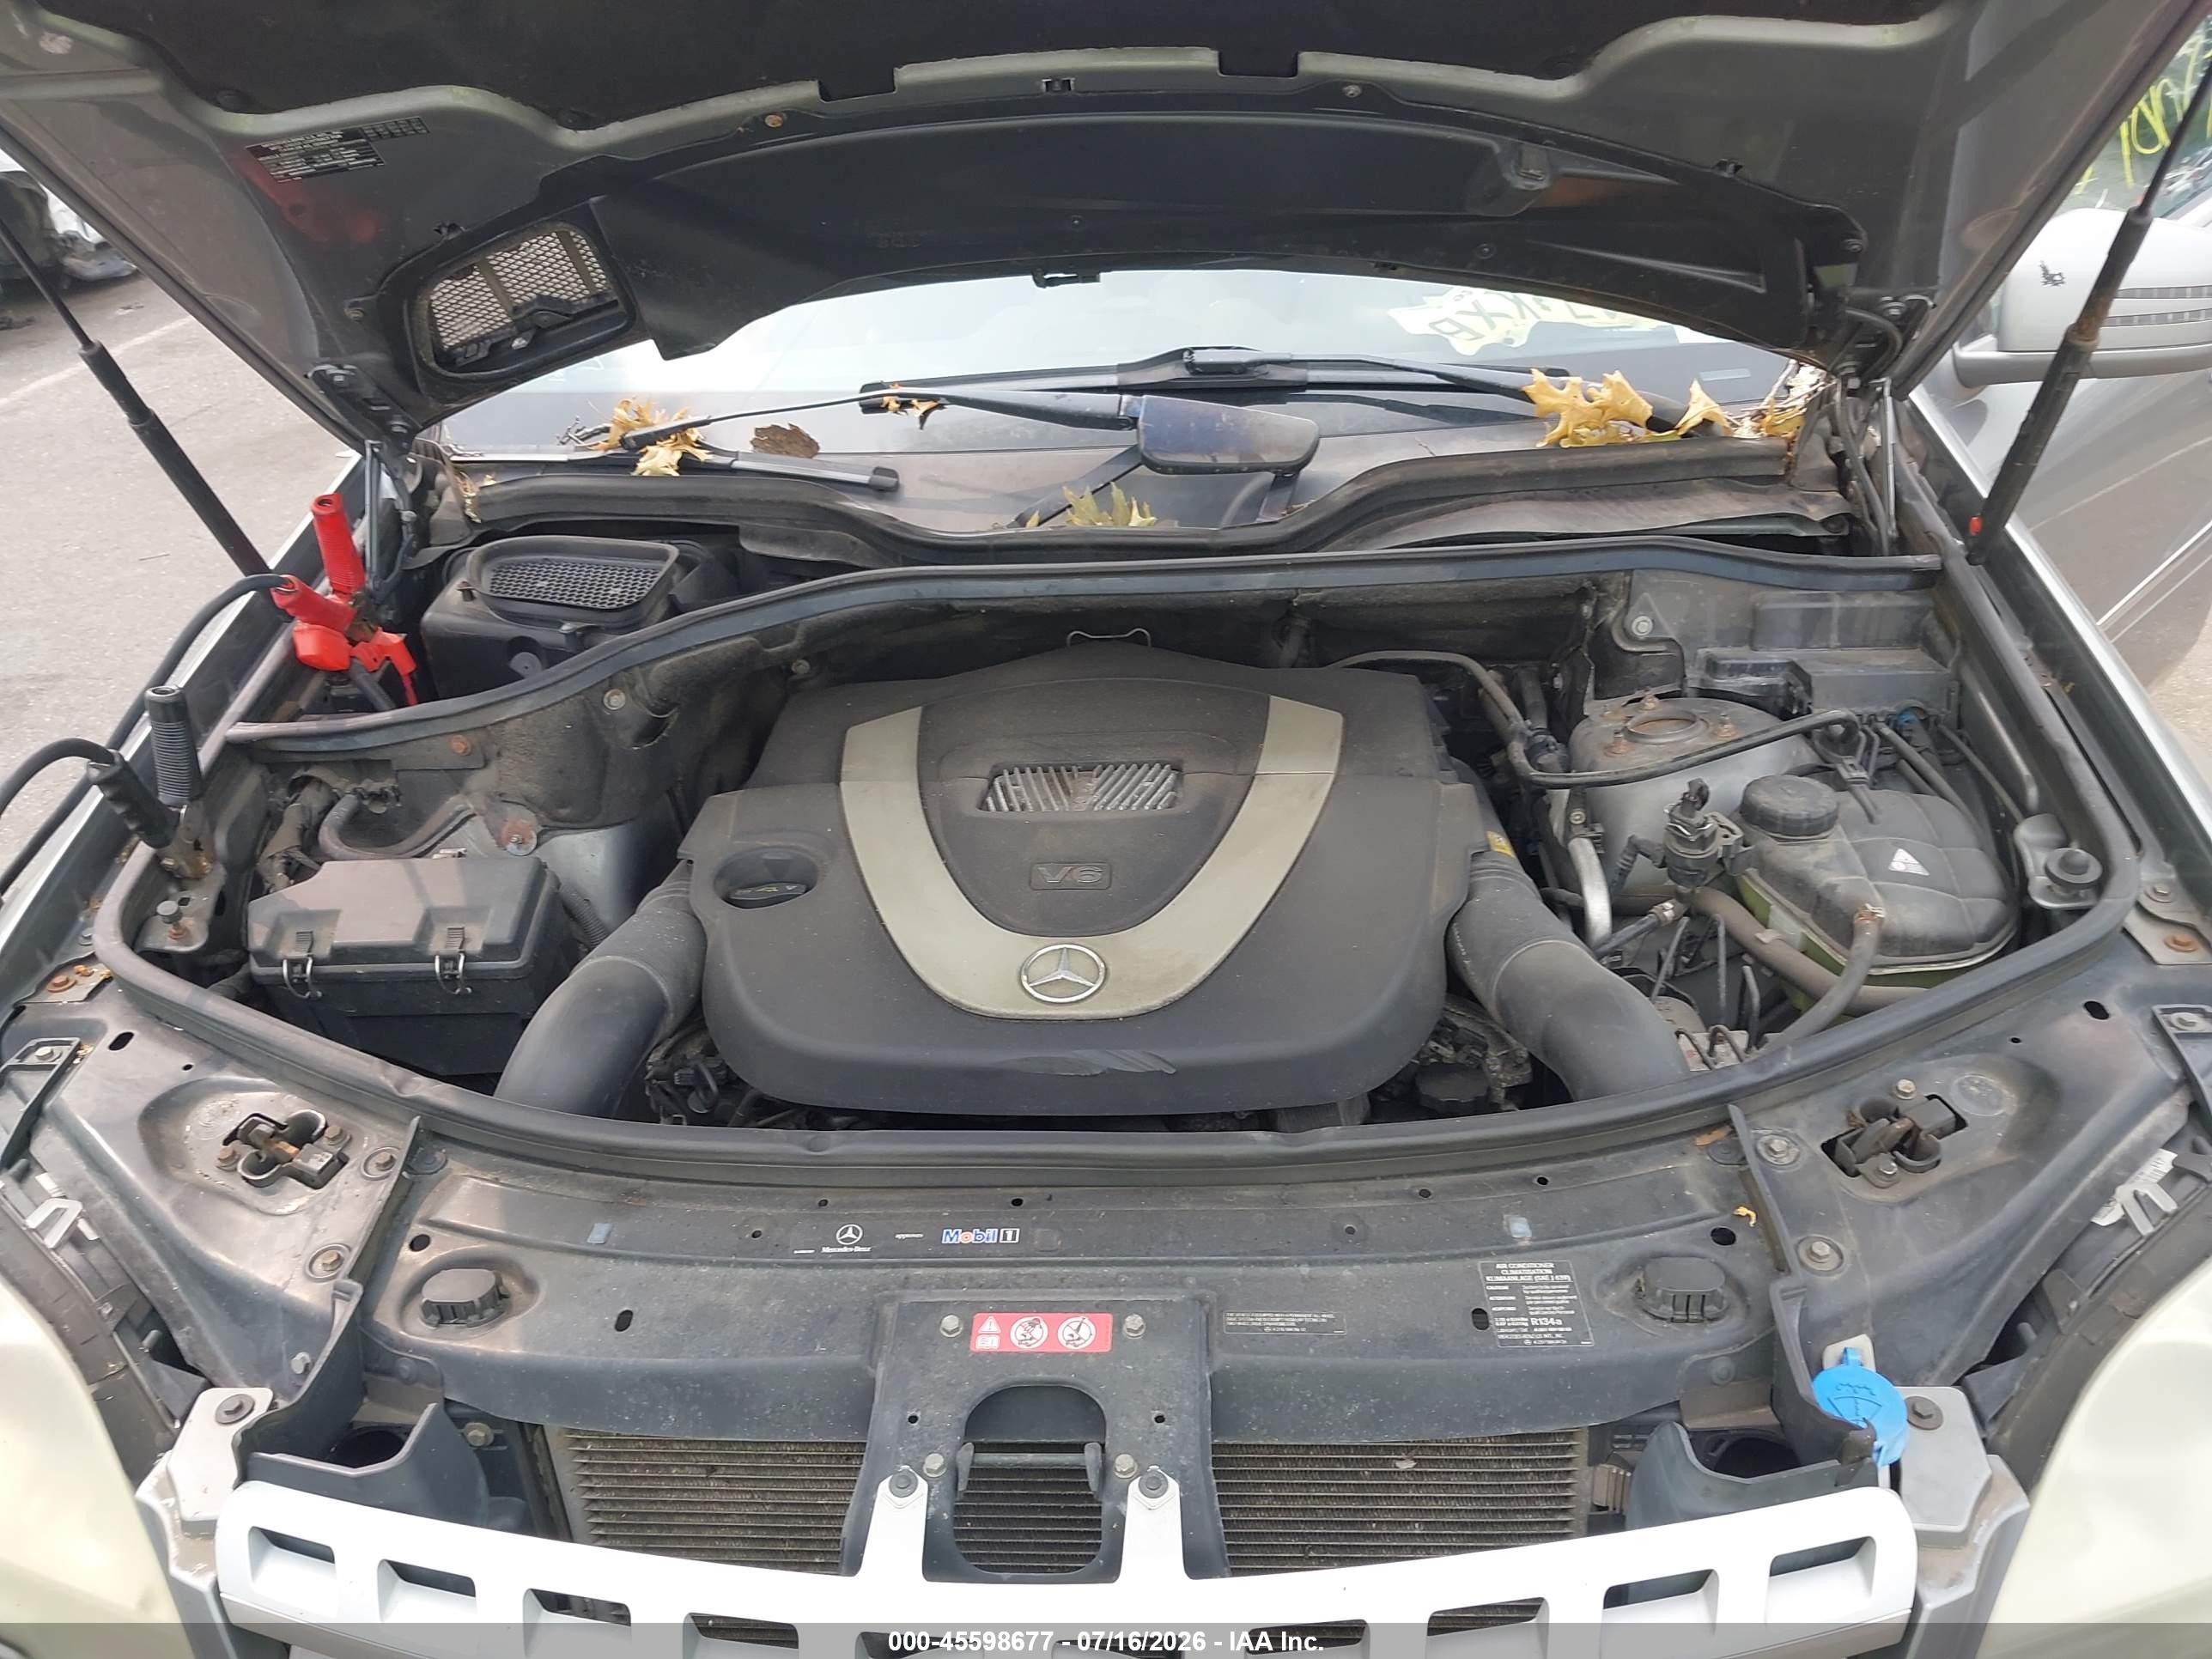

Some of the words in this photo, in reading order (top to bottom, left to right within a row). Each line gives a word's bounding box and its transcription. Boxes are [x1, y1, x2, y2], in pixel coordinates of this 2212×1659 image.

[1037, 866, 1103, 884] V6
[942, 1228, 999, 1244] Mobil
[1530, 1316, 1563, 1326] R134a
